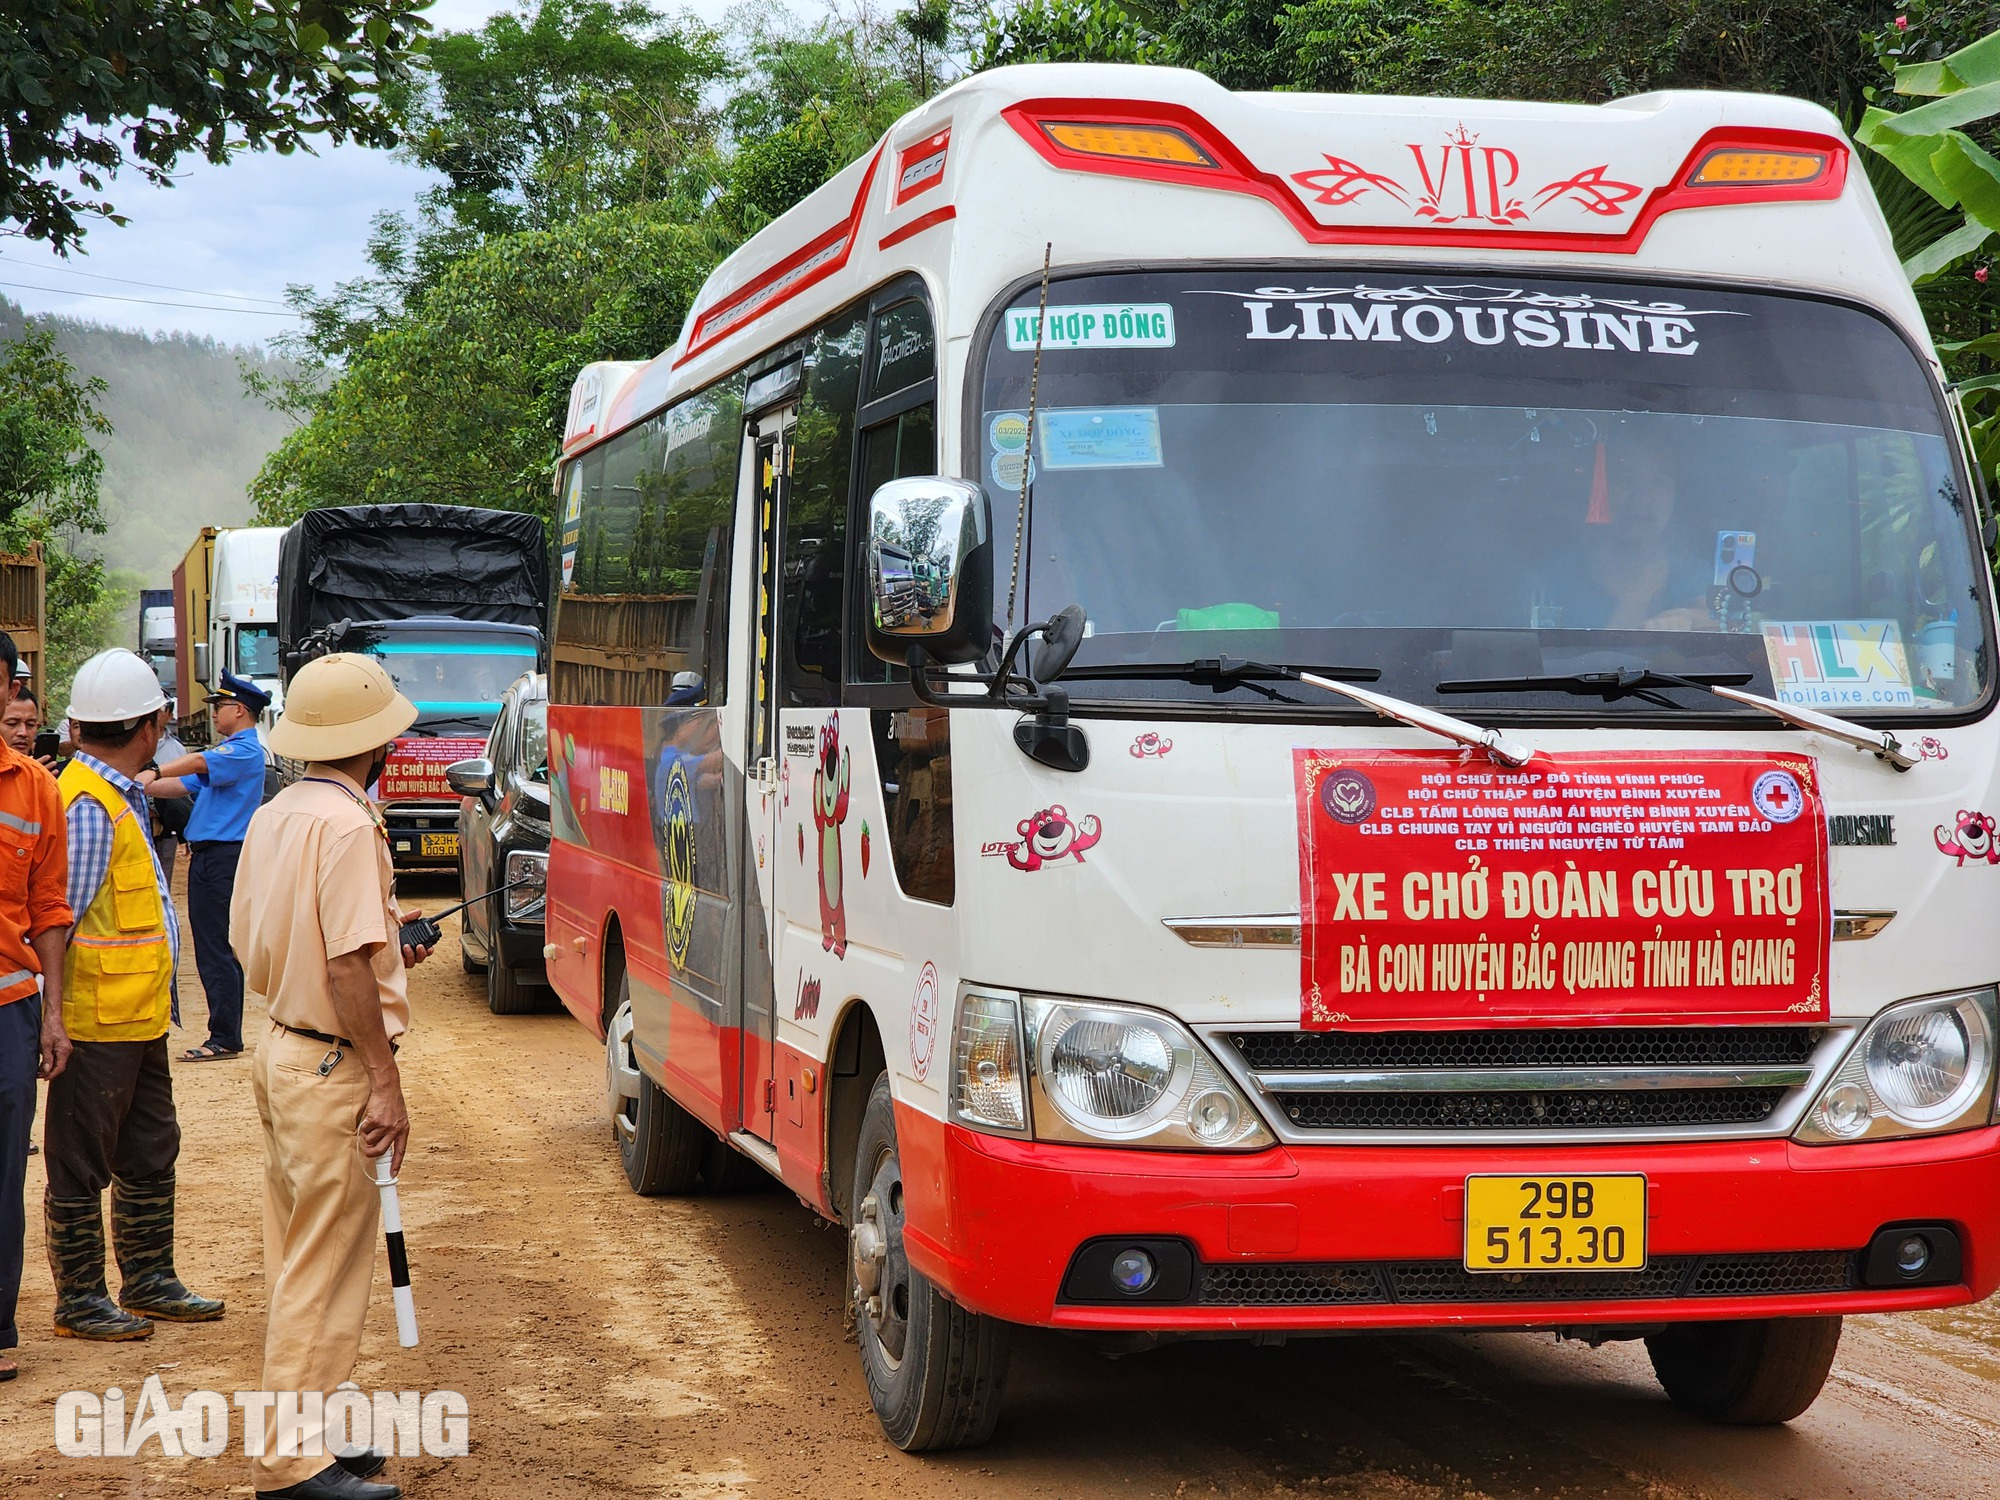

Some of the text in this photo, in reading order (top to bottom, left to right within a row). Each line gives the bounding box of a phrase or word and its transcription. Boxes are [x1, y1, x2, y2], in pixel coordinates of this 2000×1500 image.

[1405, 143, 1519, 220] VIP
[1014, 307, 1166, 345] XE HỢP ĐỒNG
[1243, 301, 1699, 356] LIMOUSINE
[998, 427, 1026, 435] 03/2025
[1766, 625, 1898, 679] HLX
[385, 763, 399, 776] XE
[426, 762, 447, 776] HÀN
[1421, 771, 1704, 786] HỘI CHỮ THẬP ĐỎ TỈNH VĨNH PHÚC
[1408, 786, 1721, 801] HỘI CHỮ THẬP ĐỎ HUYỆN BÌNH XUYÊN
[1360, 818, 1772, 835] CLB CHUNG TAY VÌ NGƯỜI NGHÈO HUYỆN TAM ĐẢO
[1380, 804, 1750, 819] CLB TẤM LÒNG NHÂN ÁI HUYỆN BÌNH XUYÊN
[434, 835, 453, 845] 23H
[1455, 836, 1684, 852] CLB THIỆN NGUYỆN TỪ TÂM
[1829, 815, 1897, 845] OUSINE
[1331, 855, 1803, 926] XE CHỞ ĐOÀN CỨU TRỢ
[1340, 924, 1795, 1001] BÀ CON HUYỆN BẮC QUANG TỈNH HÀ GIANG
[1520, 1181, 1594, 1219] 29B
[1487, 1226, 1625, 1264] 513.30
